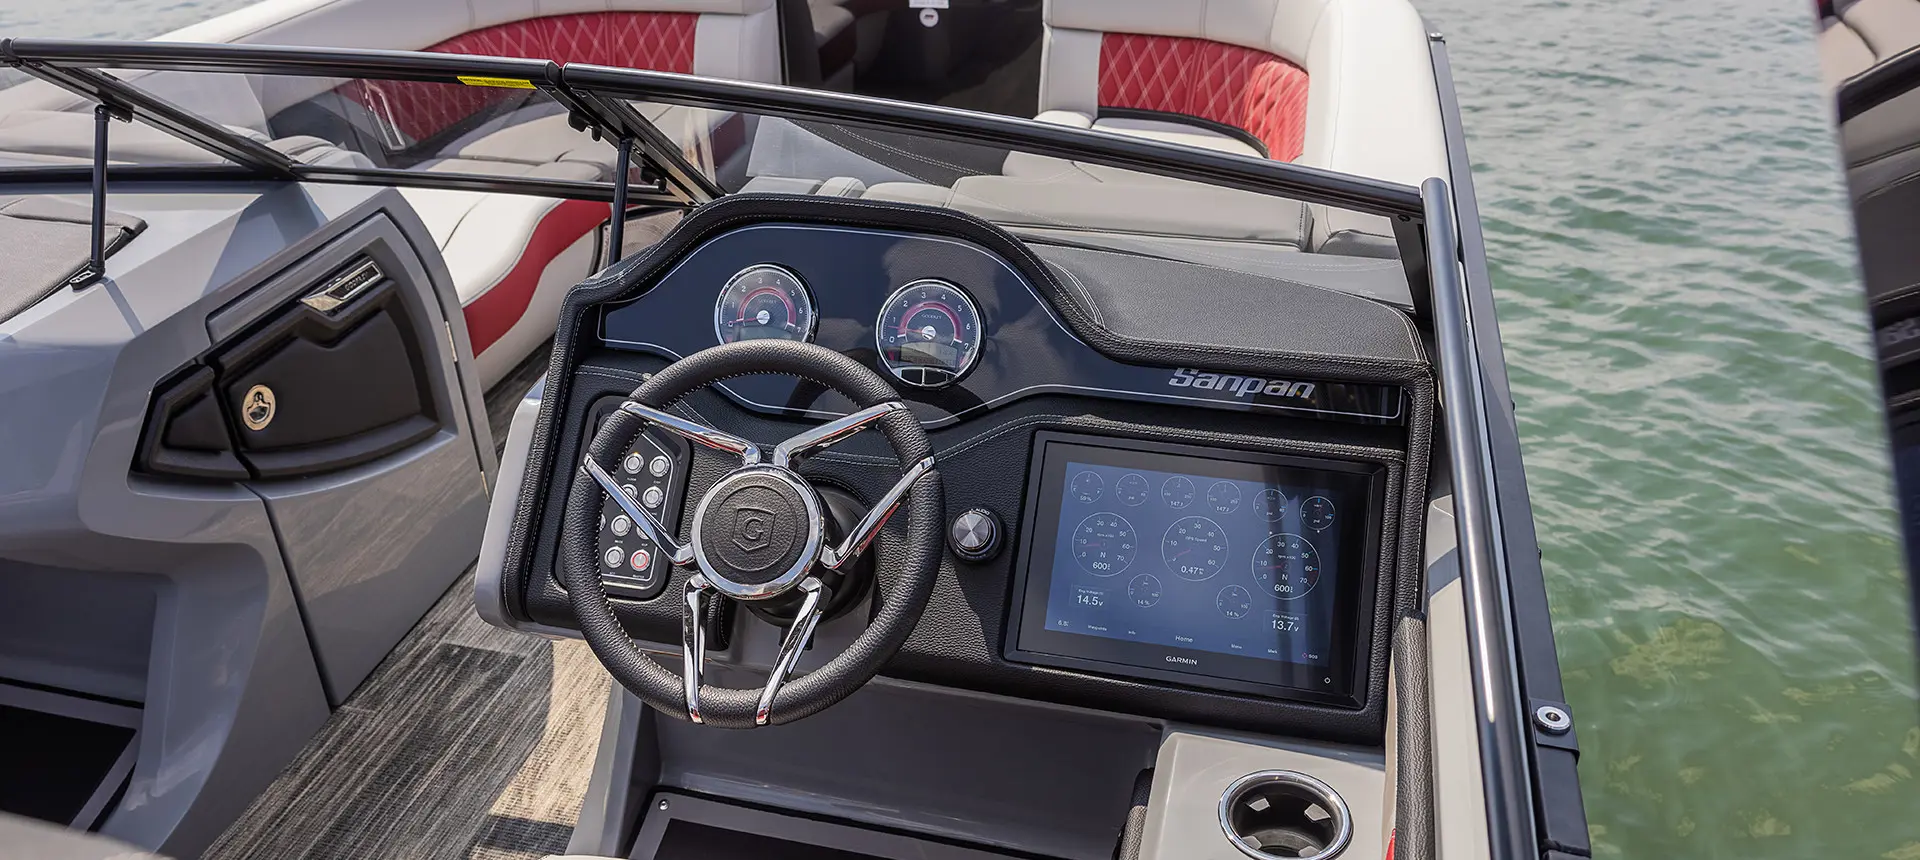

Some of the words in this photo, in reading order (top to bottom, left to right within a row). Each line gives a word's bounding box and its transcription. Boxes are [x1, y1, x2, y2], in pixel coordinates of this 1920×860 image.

[1169, 368, 1316, 398] Sanpan
[744, 516, 764, 540] G
[1092, 561, 1107, 570] 600
[1181, 565, 1198, 574] 0.47
[1274, 583, 1290, 592] 600
[1175, 635, 1194, 643] Home
[1165, 655, 1198, 665] GARMIN
